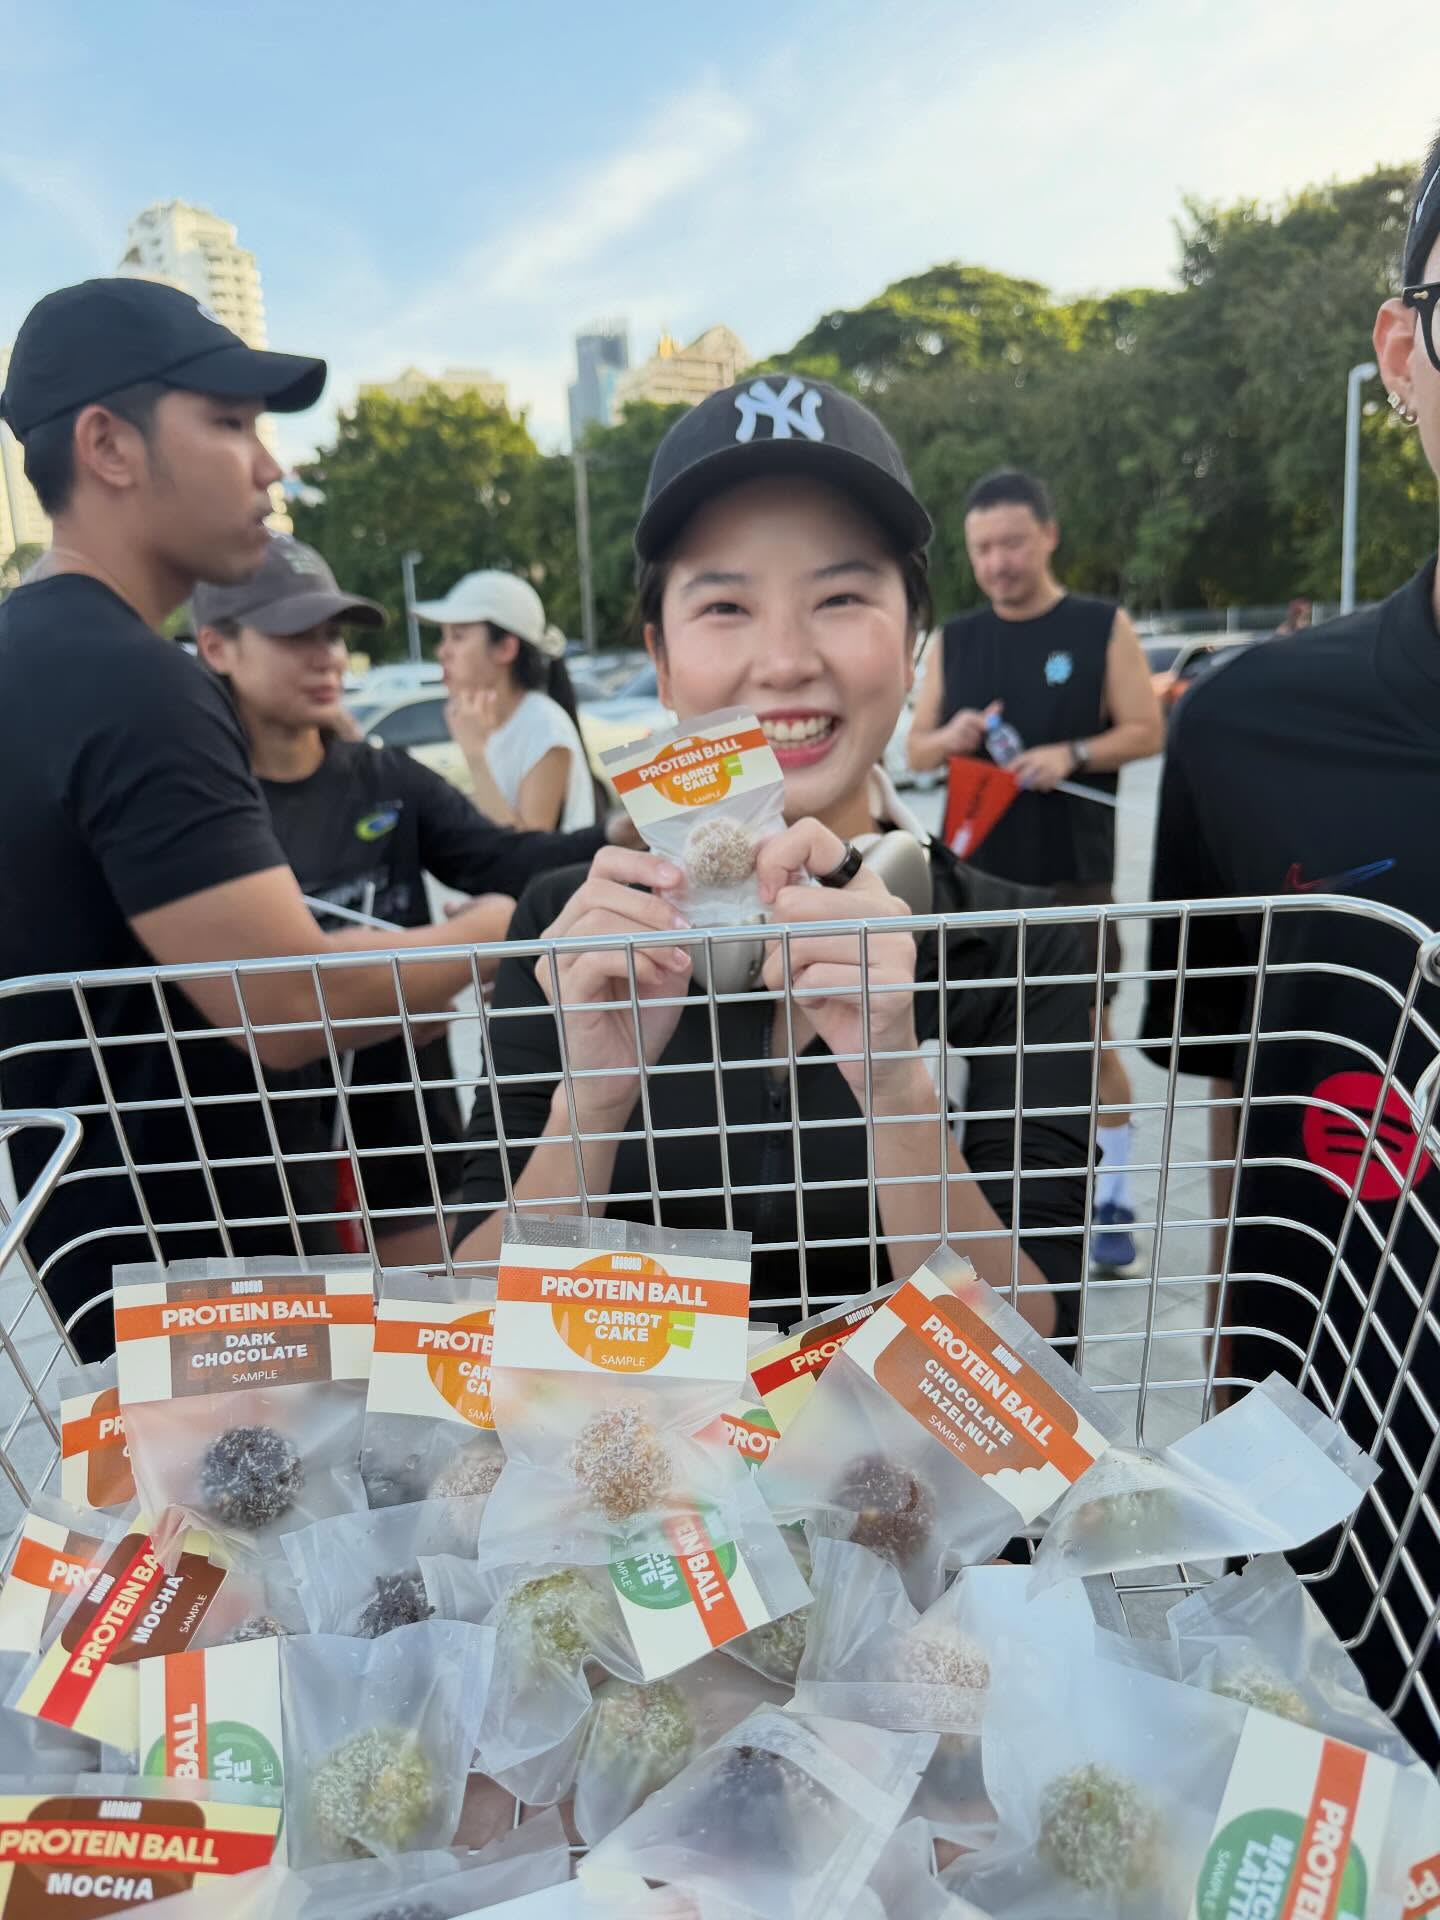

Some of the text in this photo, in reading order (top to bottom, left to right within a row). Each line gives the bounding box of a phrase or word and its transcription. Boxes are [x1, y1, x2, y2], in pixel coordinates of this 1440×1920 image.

[639, 749, 703, 781] PROTEIN
[704, 739, 742, 760] BALL
[672, 763, 720, 785] CARROT
[683, 774, 718, 791] CAKE
[541, 1276, 708, 1307] PROTEIN BALL
[162, 1300, 332, 1329] PROTEIN BALL
[584, 1309, 662, 1329] CARROT
[225, 1332, 276, 1348] DARK
[595, 1324, 649, 1342] CAKE
[192, 1344, 308, 1368] CHOCOLATE
[600, 1355, 646, 1367] SAMPLE
[232, 1369, 278, 1383] SAMPLE
[466, 1379, 491, 1396] CA
[921, 1314, 1008, 1400] PROTEIN
[1000, 1390, 1053, 1447] BALL
[918, 1377, 998, 1455] HAZELNUT
[925, 1360, 1014, 1446] CHOCOLATE
[928, 1415, 967, 1453] SAMPLE
[687, 1552, 725, 1611] BALL
[131, 1575, 184, 1644] MOCHA
[180, 1594, 208, 1633] SAMPLE
[71, 1580, 140, 1678] PROTEIN
[173, 1703, 199, 1779] BALL
[0, 1828, 219, 1865] PROTEIN BALL
[46, 1872, 154, 1900] MOCHA
